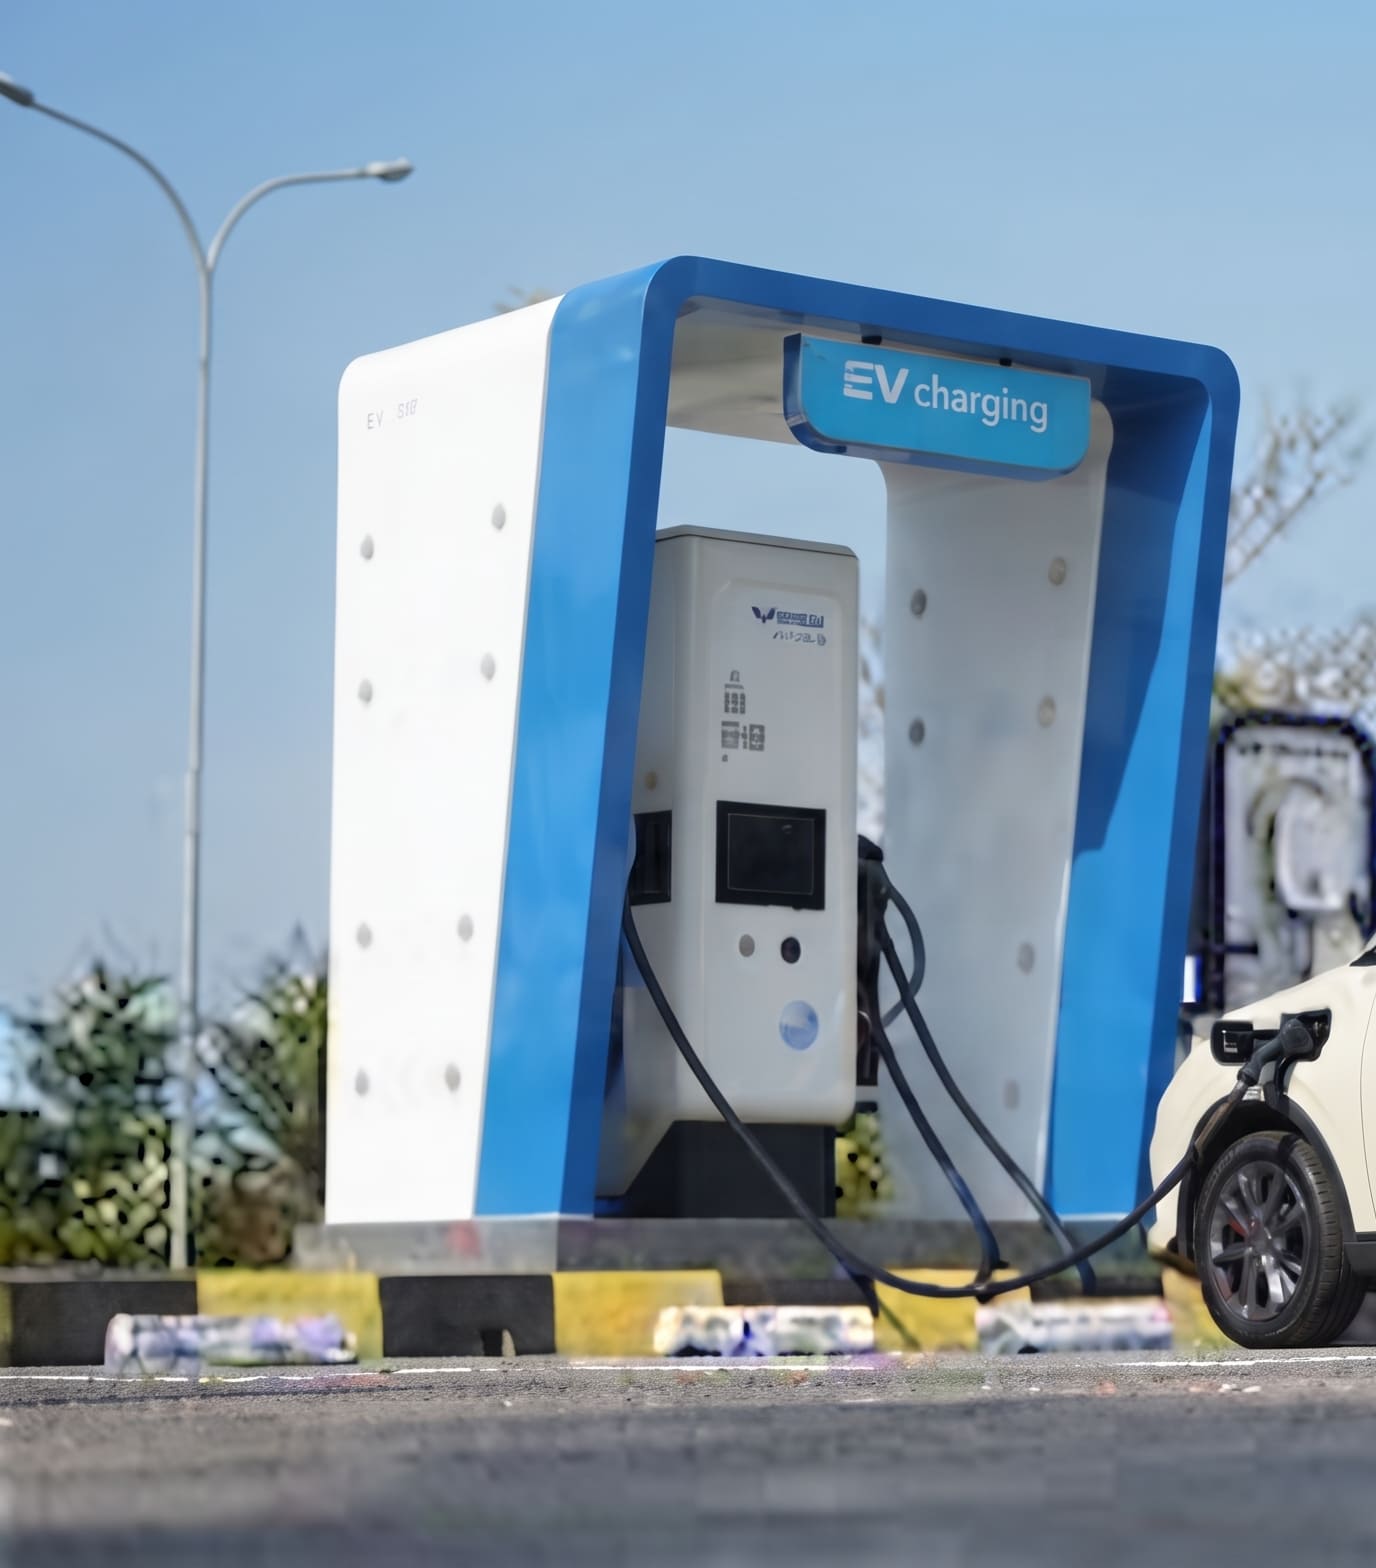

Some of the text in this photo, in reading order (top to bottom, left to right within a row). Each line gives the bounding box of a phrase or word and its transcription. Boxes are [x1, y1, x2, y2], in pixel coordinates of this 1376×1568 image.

[843, 360, 1048, 433] EV charging
[367, 410, 384, 430] EV
